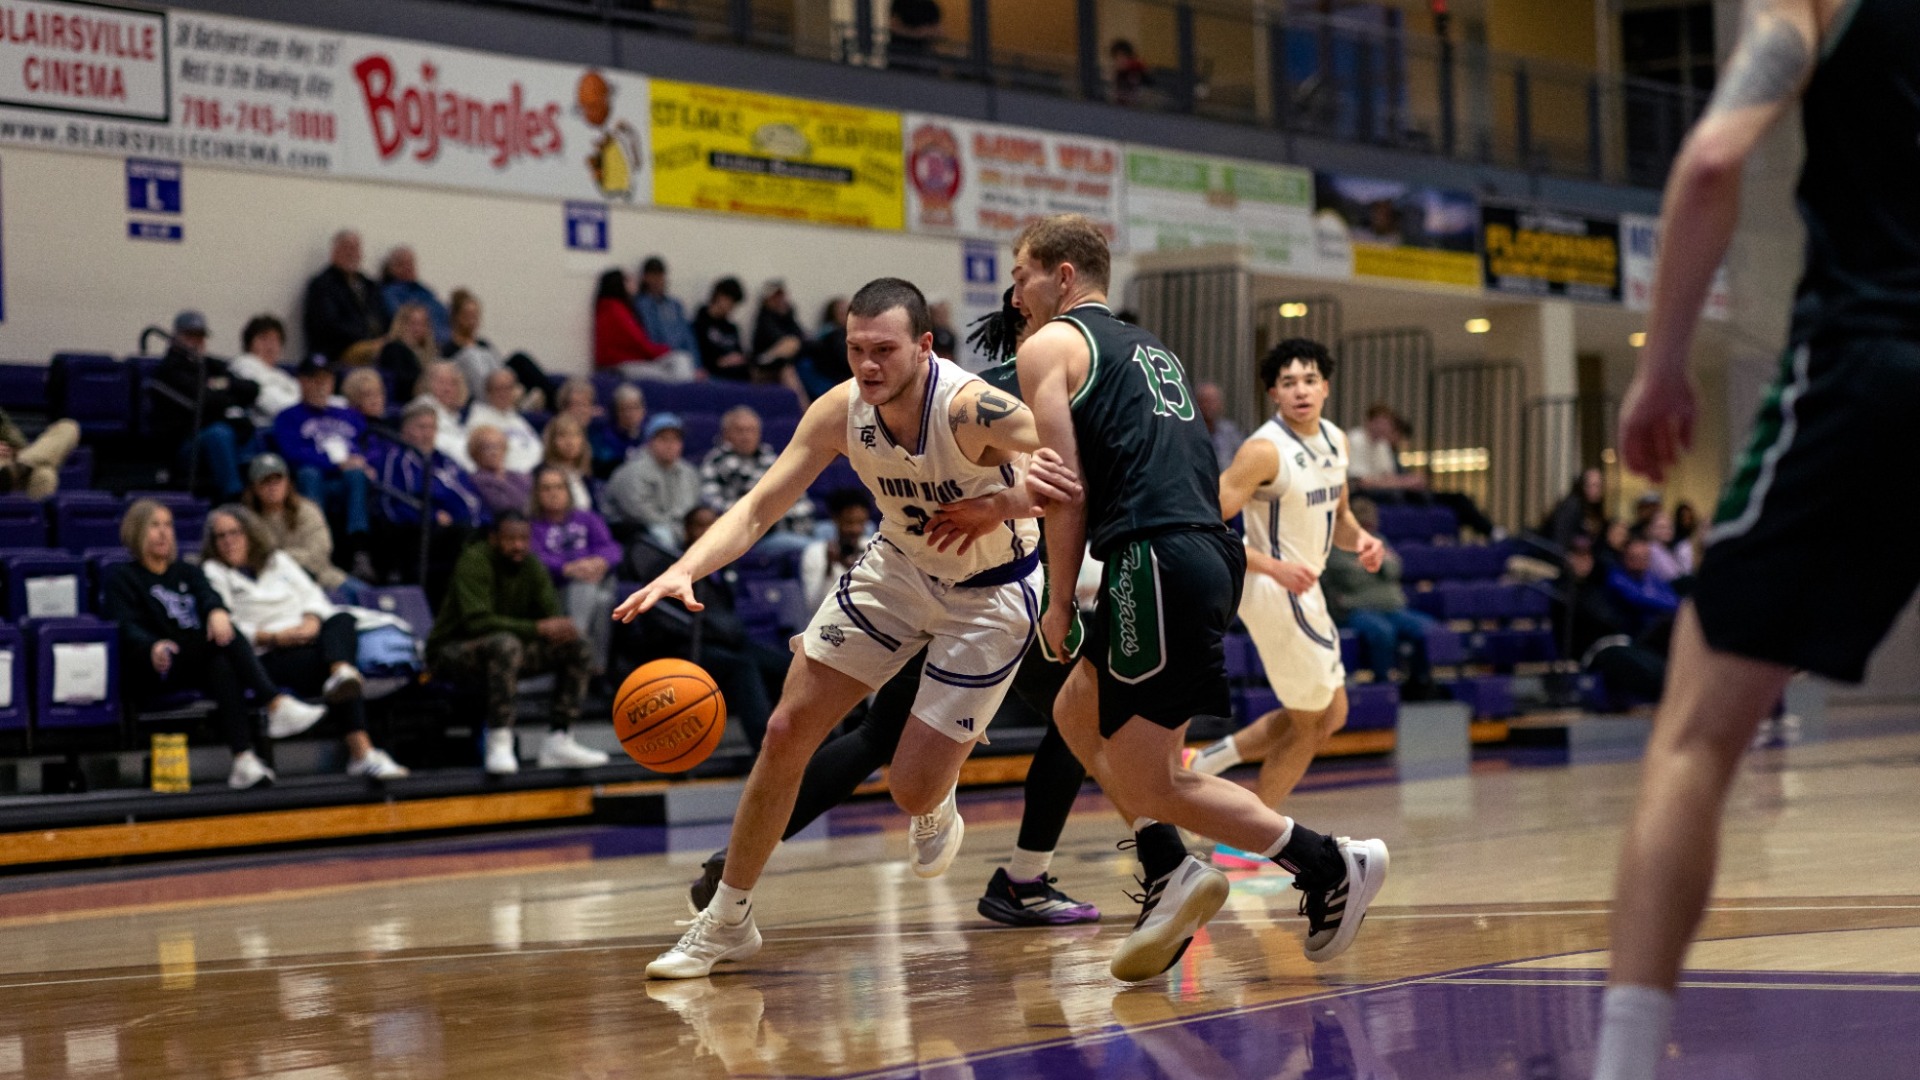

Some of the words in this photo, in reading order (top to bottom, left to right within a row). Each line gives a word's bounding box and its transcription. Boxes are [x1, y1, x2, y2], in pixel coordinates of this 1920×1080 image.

[23, 57, 127, 99] CINEMA
[353, 56, 562, 168] Bojangles
[146, 180, 163, 210] L
[1132, 344, 1195, 420] 13
[1110, 541, 1140, 657] Trojans
[626, 686, 676, 725] NCAA
[635, 714, 704, 754] Wilson
